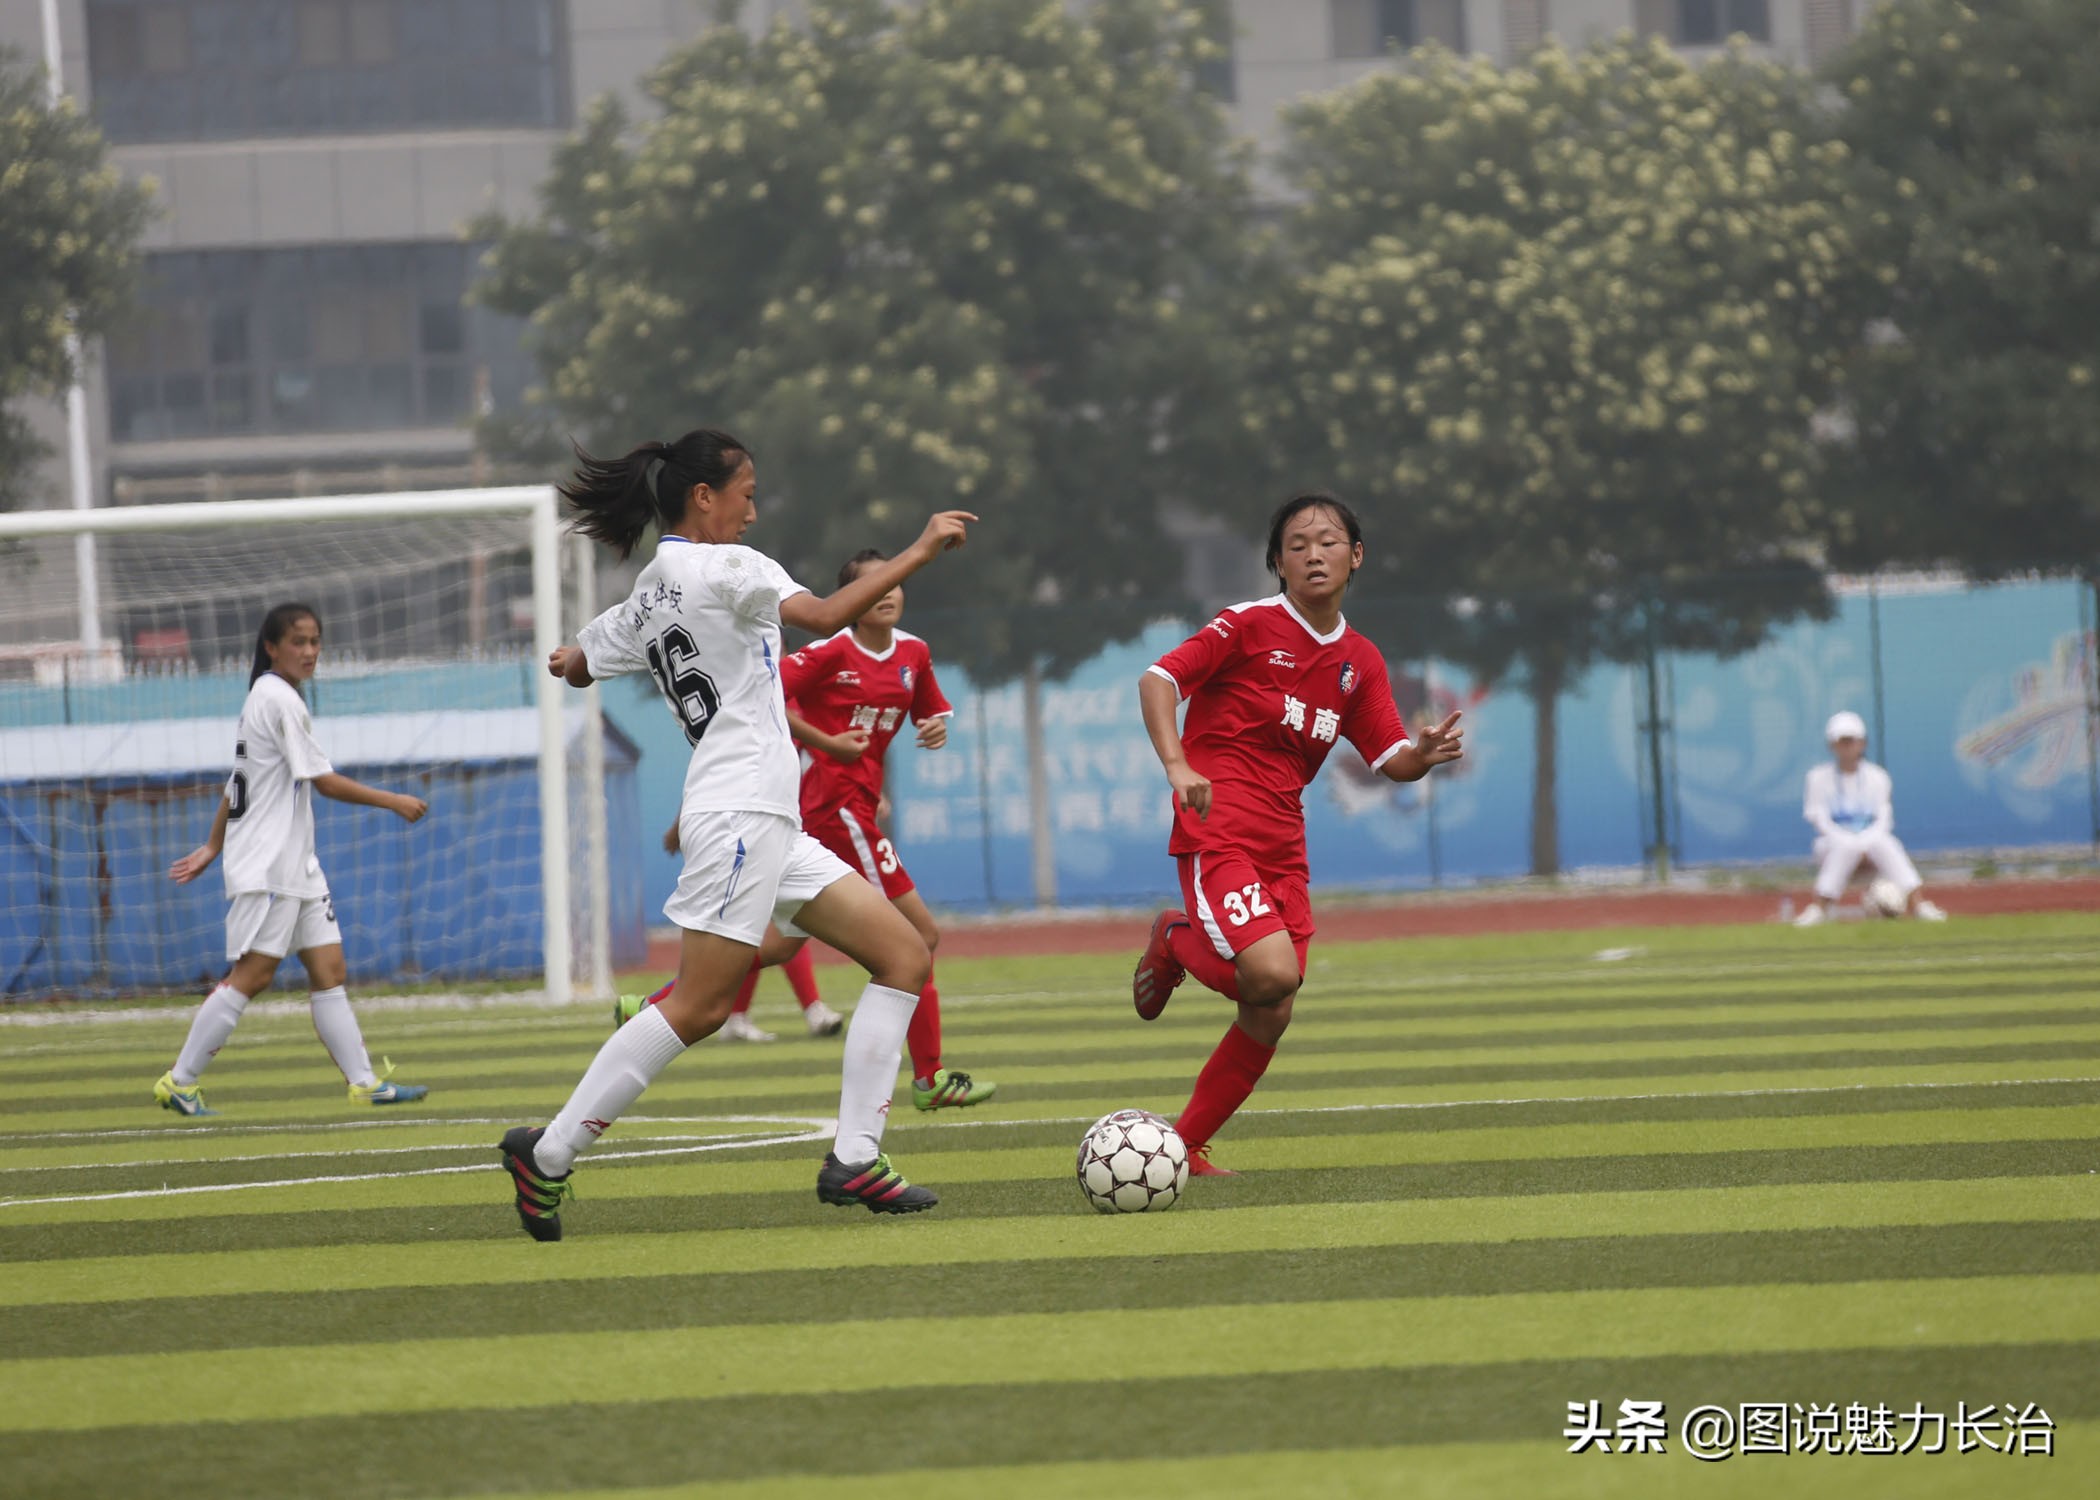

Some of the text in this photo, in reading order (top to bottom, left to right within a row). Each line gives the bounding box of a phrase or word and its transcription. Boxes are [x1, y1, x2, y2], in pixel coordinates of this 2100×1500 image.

[1281, 694, 1340, 743] 海南
[876, 837, 903, 874] 3
[1223, 882, 1270, 927] 32
